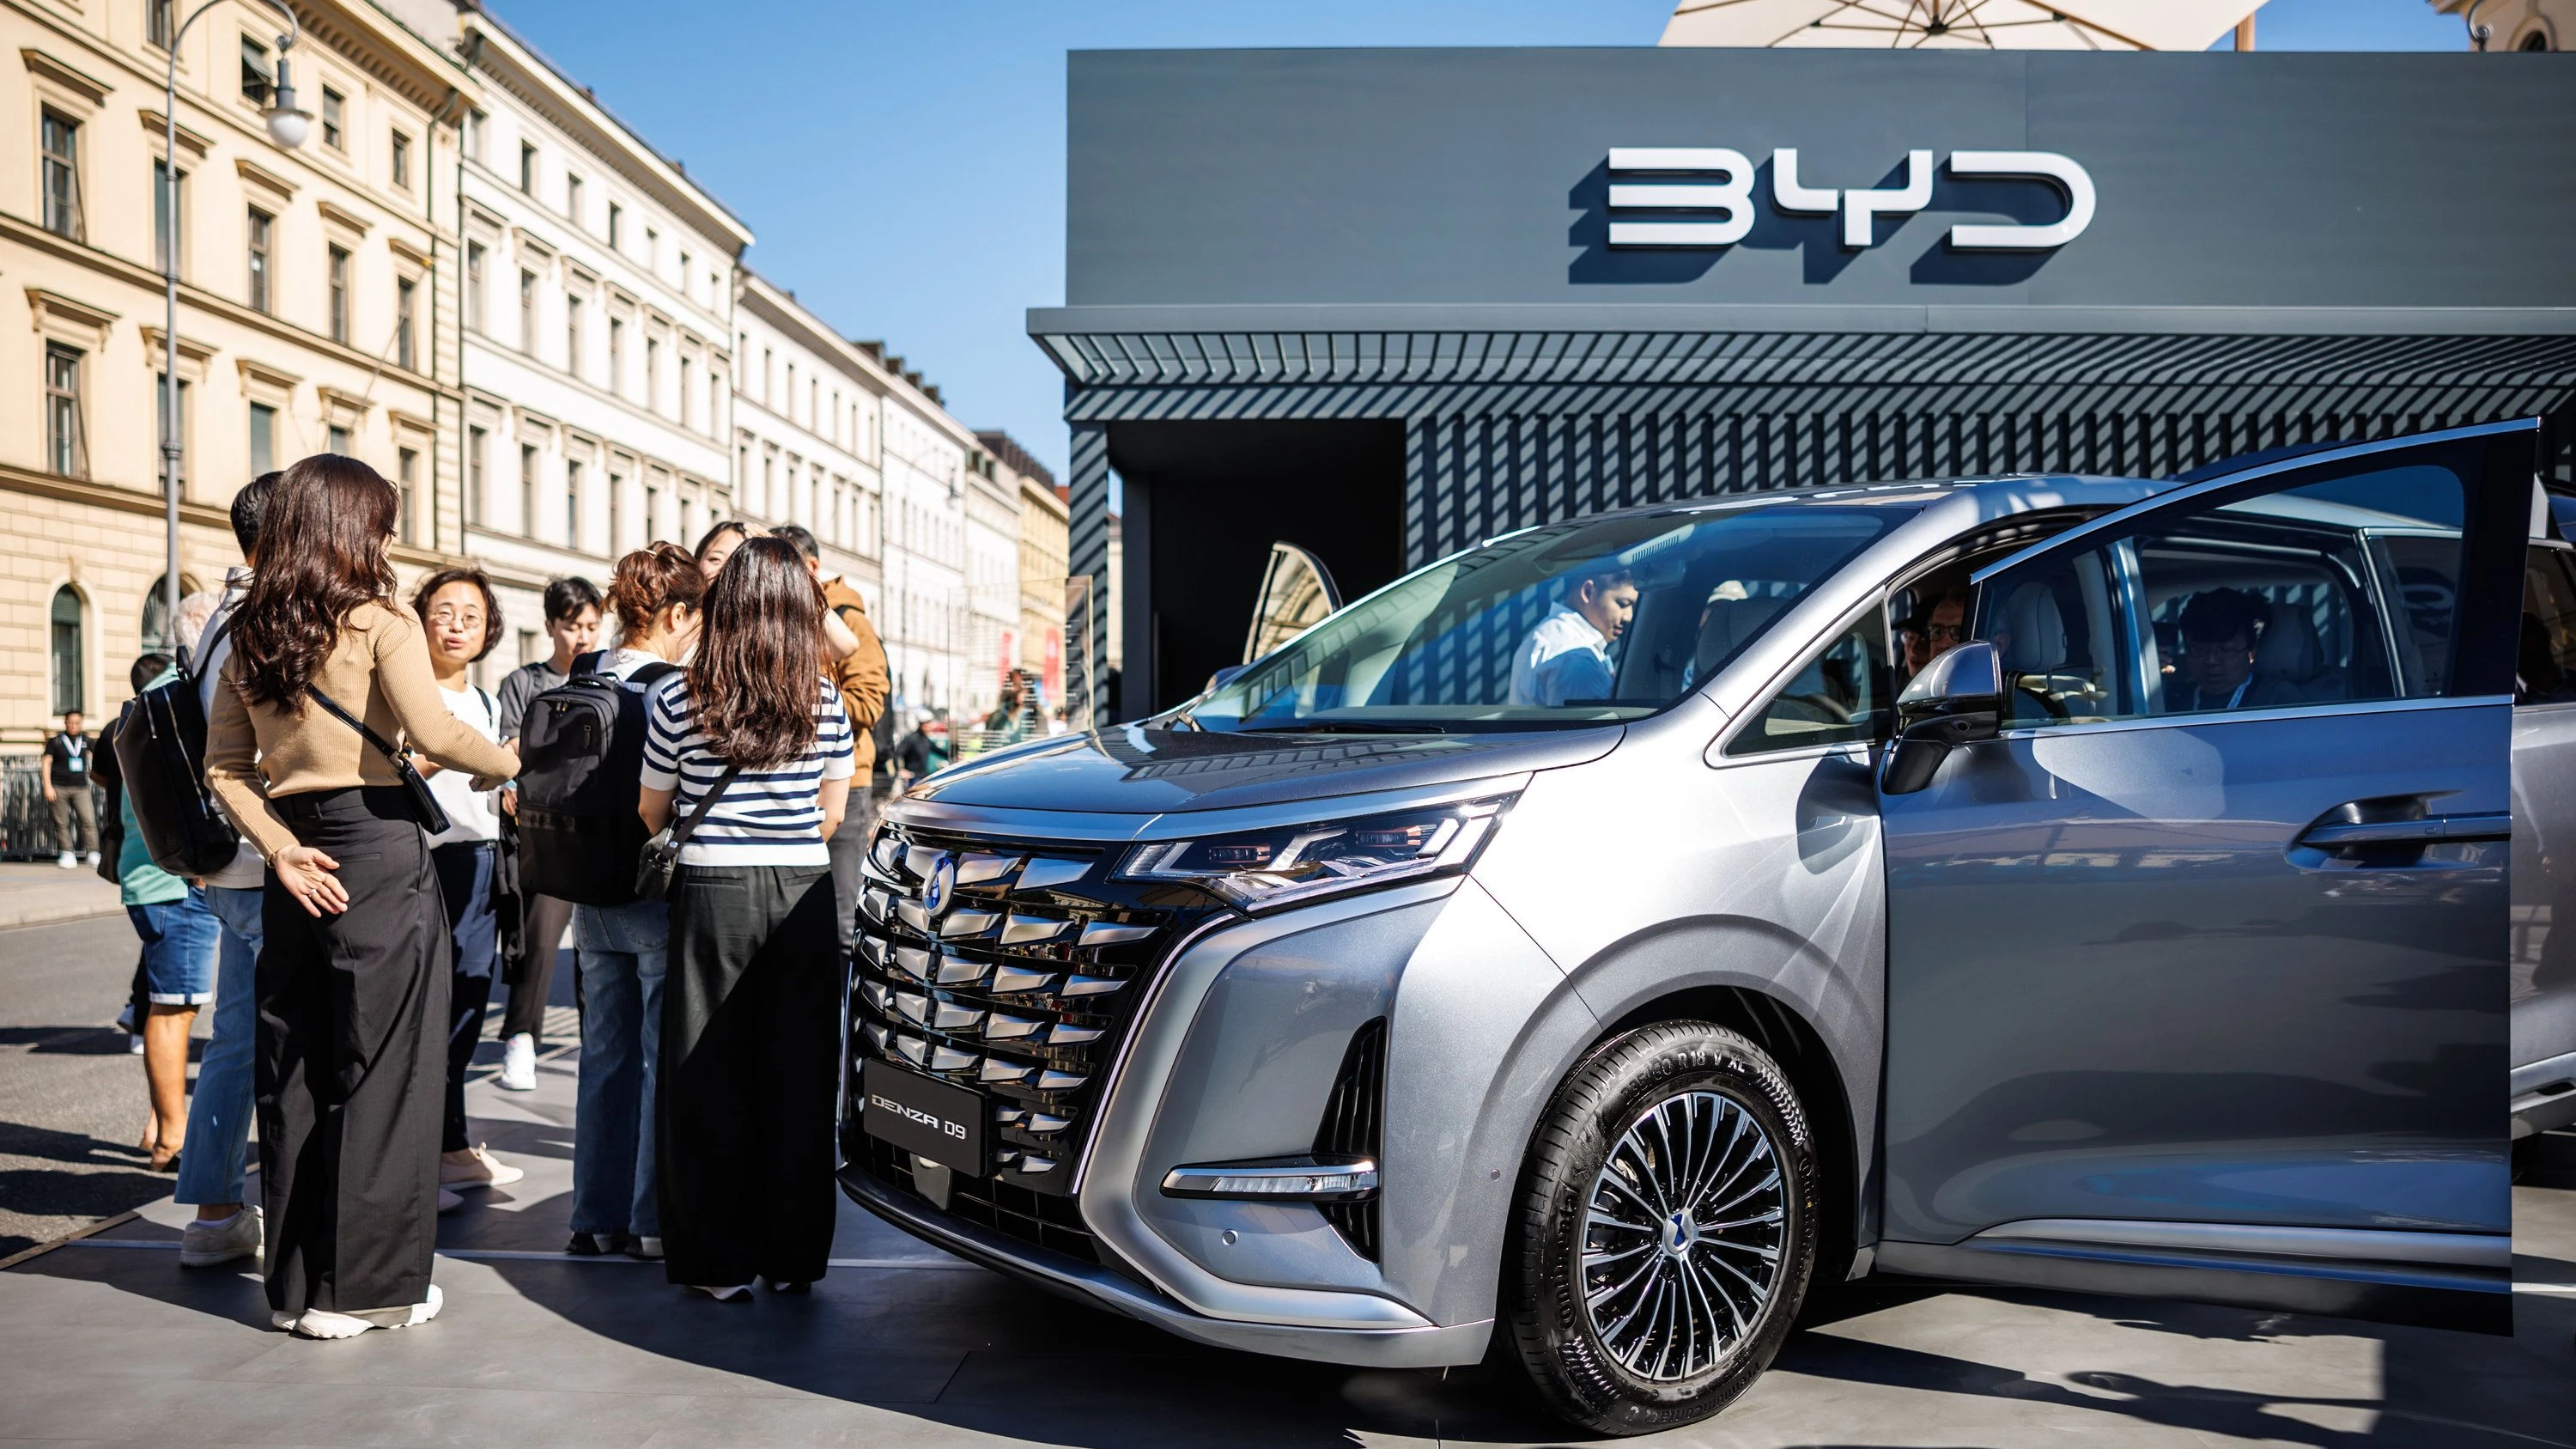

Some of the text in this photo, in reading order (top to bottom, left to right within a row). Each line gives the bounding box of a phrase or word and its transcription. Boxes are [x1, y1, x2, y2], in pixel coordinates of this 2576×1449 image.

[1609, 147, 2096, 247] BYD
[872, 1094, 966, 1140] DENZA D9
